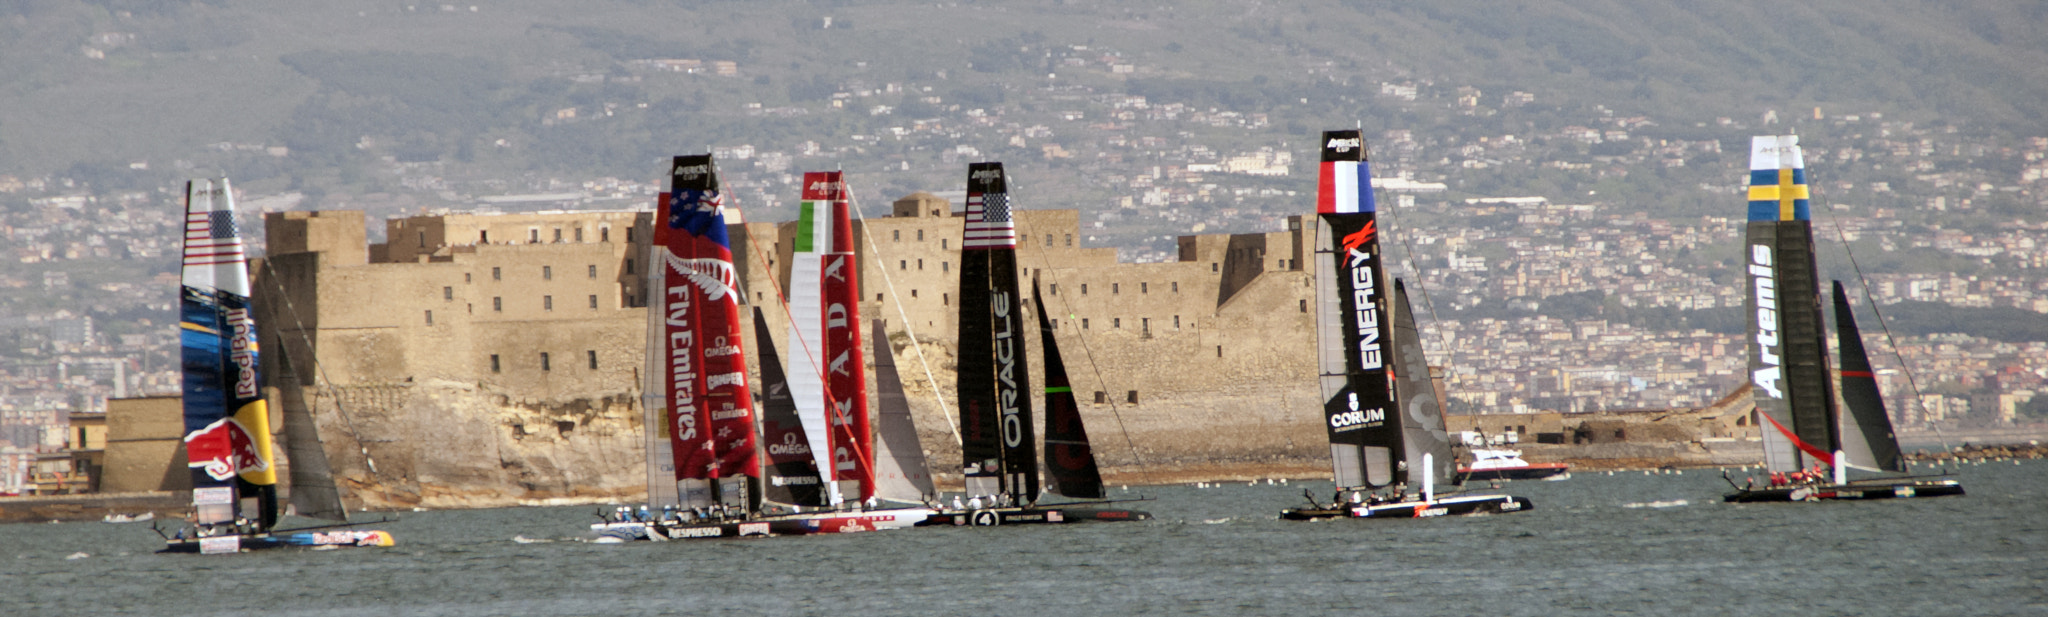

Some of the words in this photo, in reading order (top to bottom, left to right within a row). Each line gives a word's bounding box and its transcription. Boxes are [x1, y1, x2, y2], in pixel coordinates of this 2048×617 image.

[666, 284, 690, 327] Fly
[1350, 247, 1383, 370] ENERGY
[1749, 244, 1783, 399] Artemis
[671, 329, 697, 441] Emirates
[704, 345, 741, 358] OMEGA
[825, 254, 857, 472] PRADA
[993, 291, 1022, 448] ORACLE
[769, 443, 811, 455] OMEGA
[1331, 408, 1385, 427] CORUM
[979, 513, 992, 526] 4
